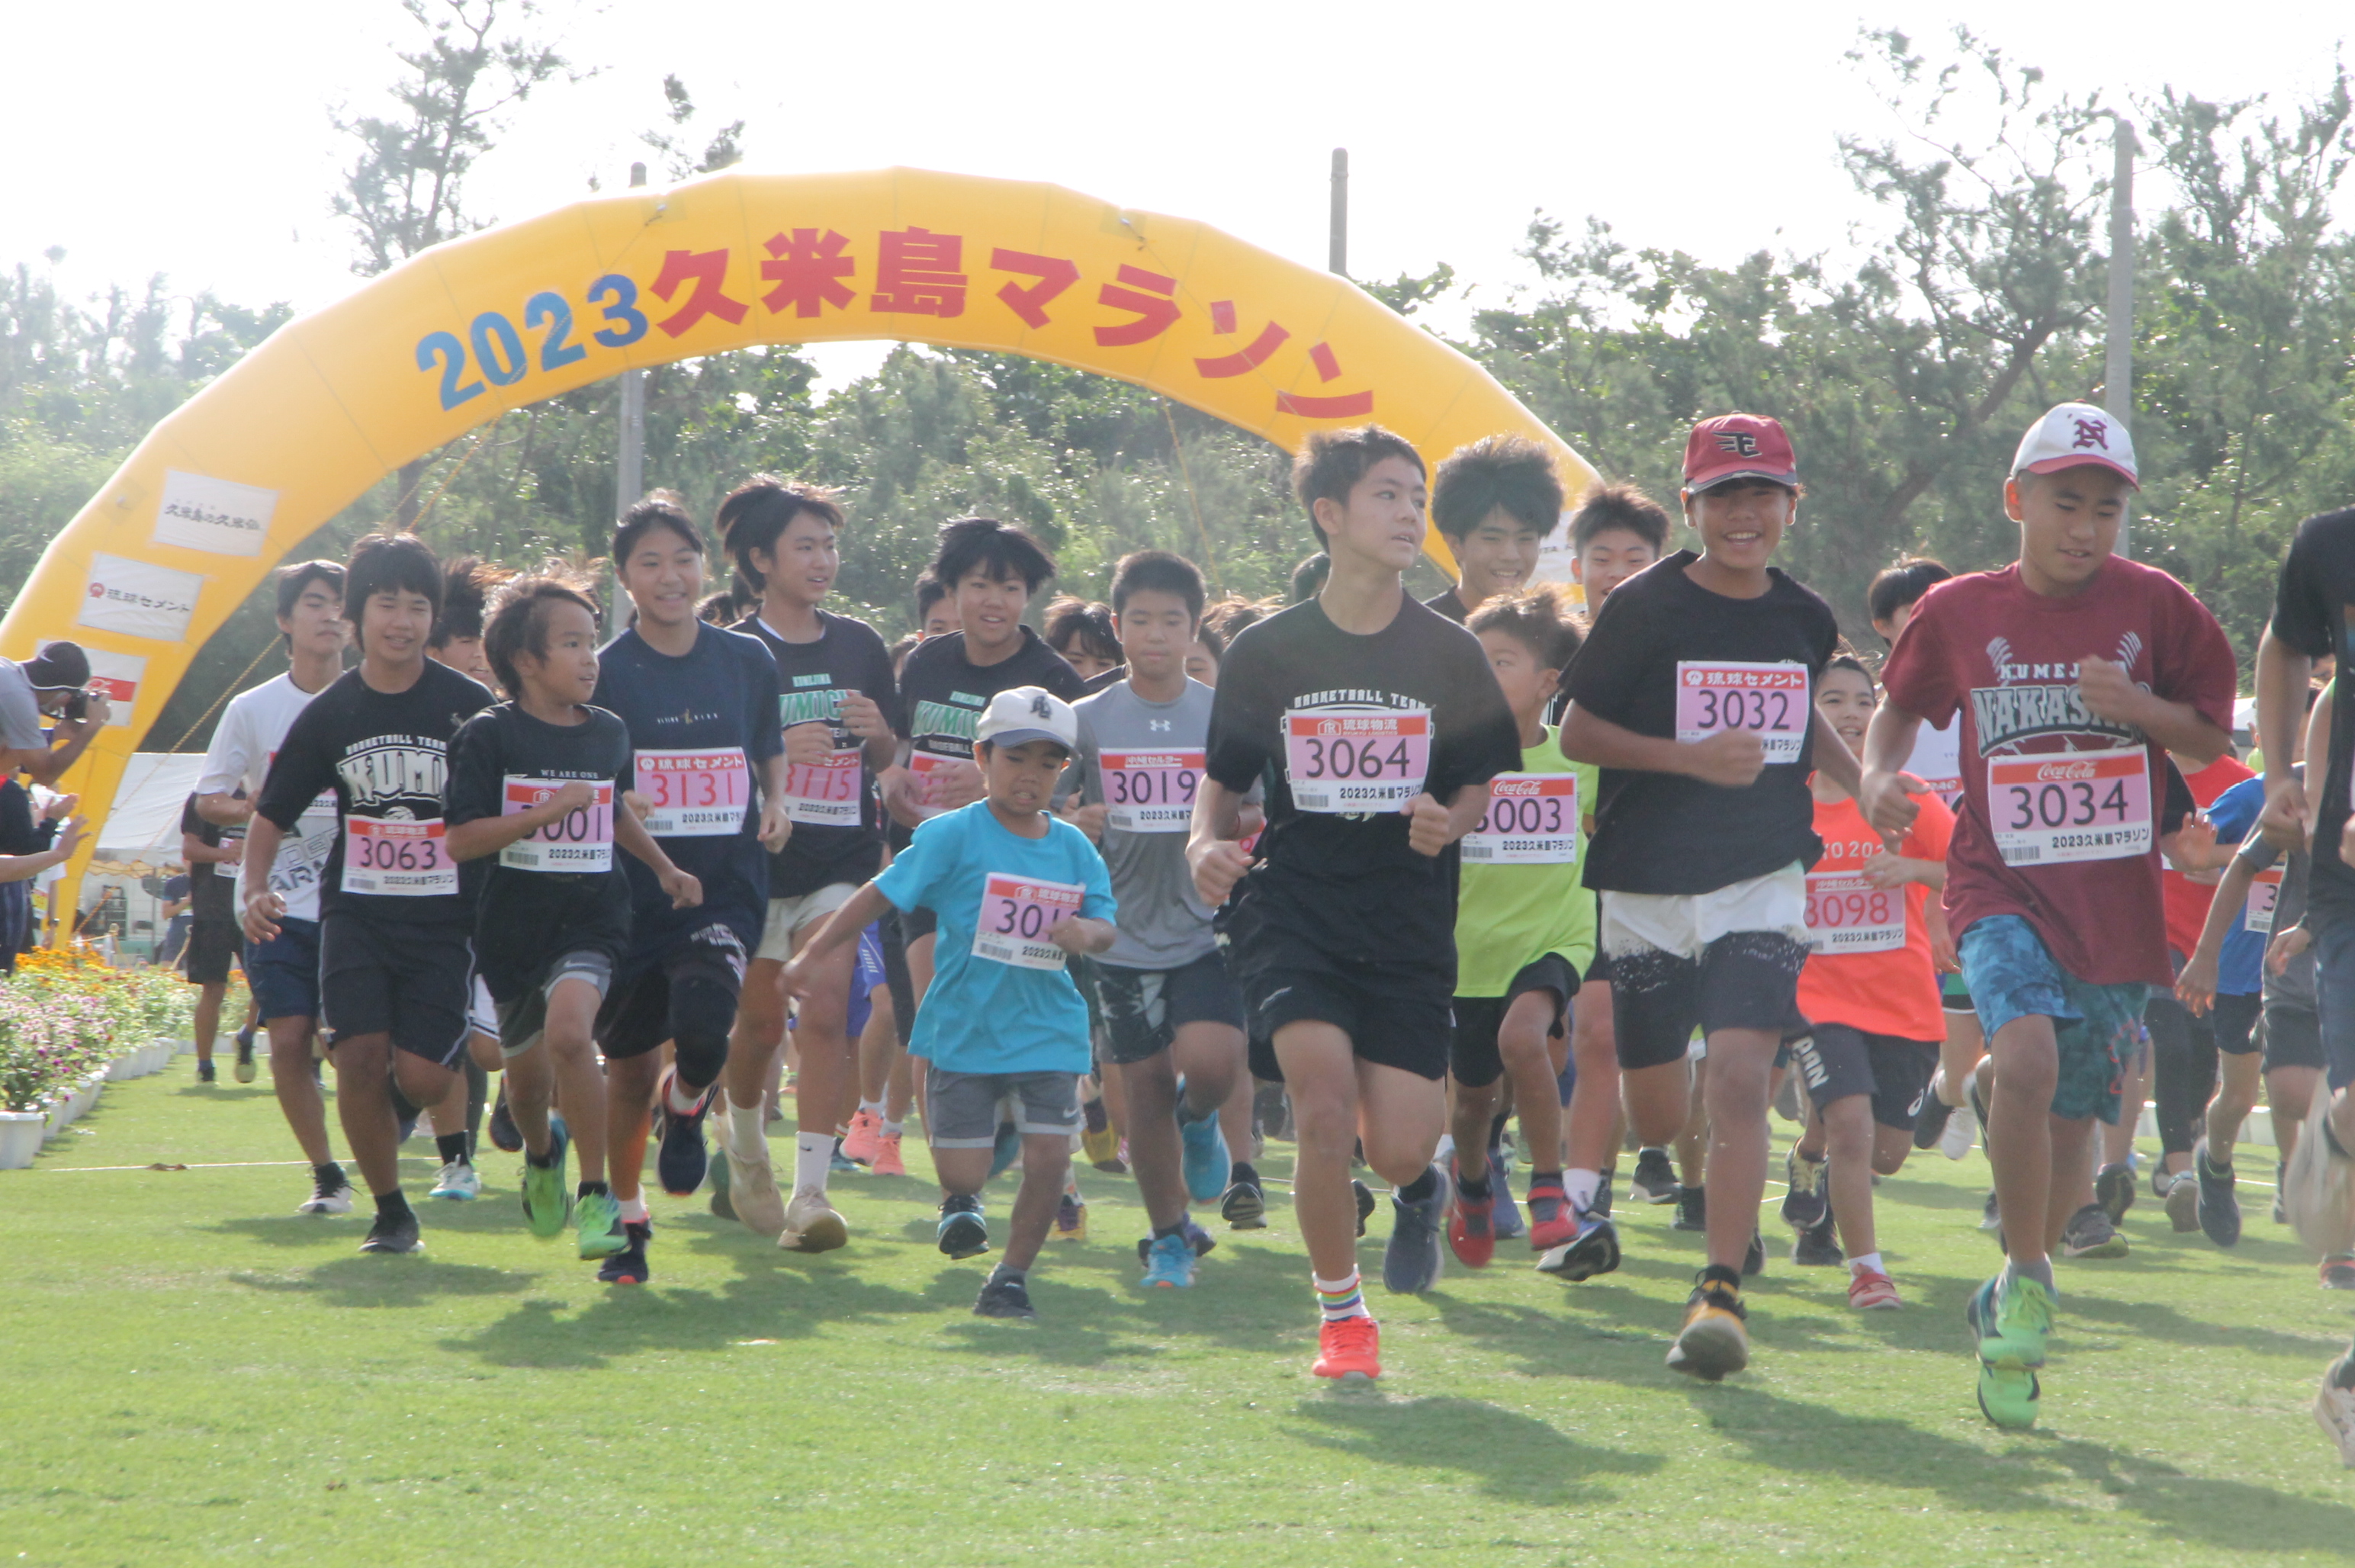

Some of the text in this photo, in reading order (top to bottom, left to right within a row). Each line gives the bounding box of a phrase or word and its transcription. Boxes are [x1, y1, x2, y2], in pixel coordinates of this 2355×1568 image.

[1707, 671, 1802, 687] 琉球セメント
[2000, 661, 2126, 679] KUMEJ
[1294, 689, 1383, 708] BASKETBALL
[1698, 689, 1790, 730] 3032
[1343, 719, 1398, 731] 琉球物流
[1971, 685, 2149, 755] NAKAS
[1306, 738, 1410, 778] 3064
[1761, 738, 1802, 751] 米島マラソン
[337, 750, 449, 807] KUM
[657, 756, 743, 770] 琉球セメント
[651, 772, 733, 807] 3131
[1113, 770, 1196, 803] 3019
[1140, 810, 1191, 821] 2023久米島マ
[2010, 779, 2128, 830] 3034
[361, 837, 436, 870] 3063
[1849, 840, 1887, 858] 202
[2052, 828, 2150, 848] 2023久米島マラソン
[995, 898, 1080, 941] 301
[1806, 892, 1890, 927] 3098
[1792, 1036, 1830, 1089] PAN
